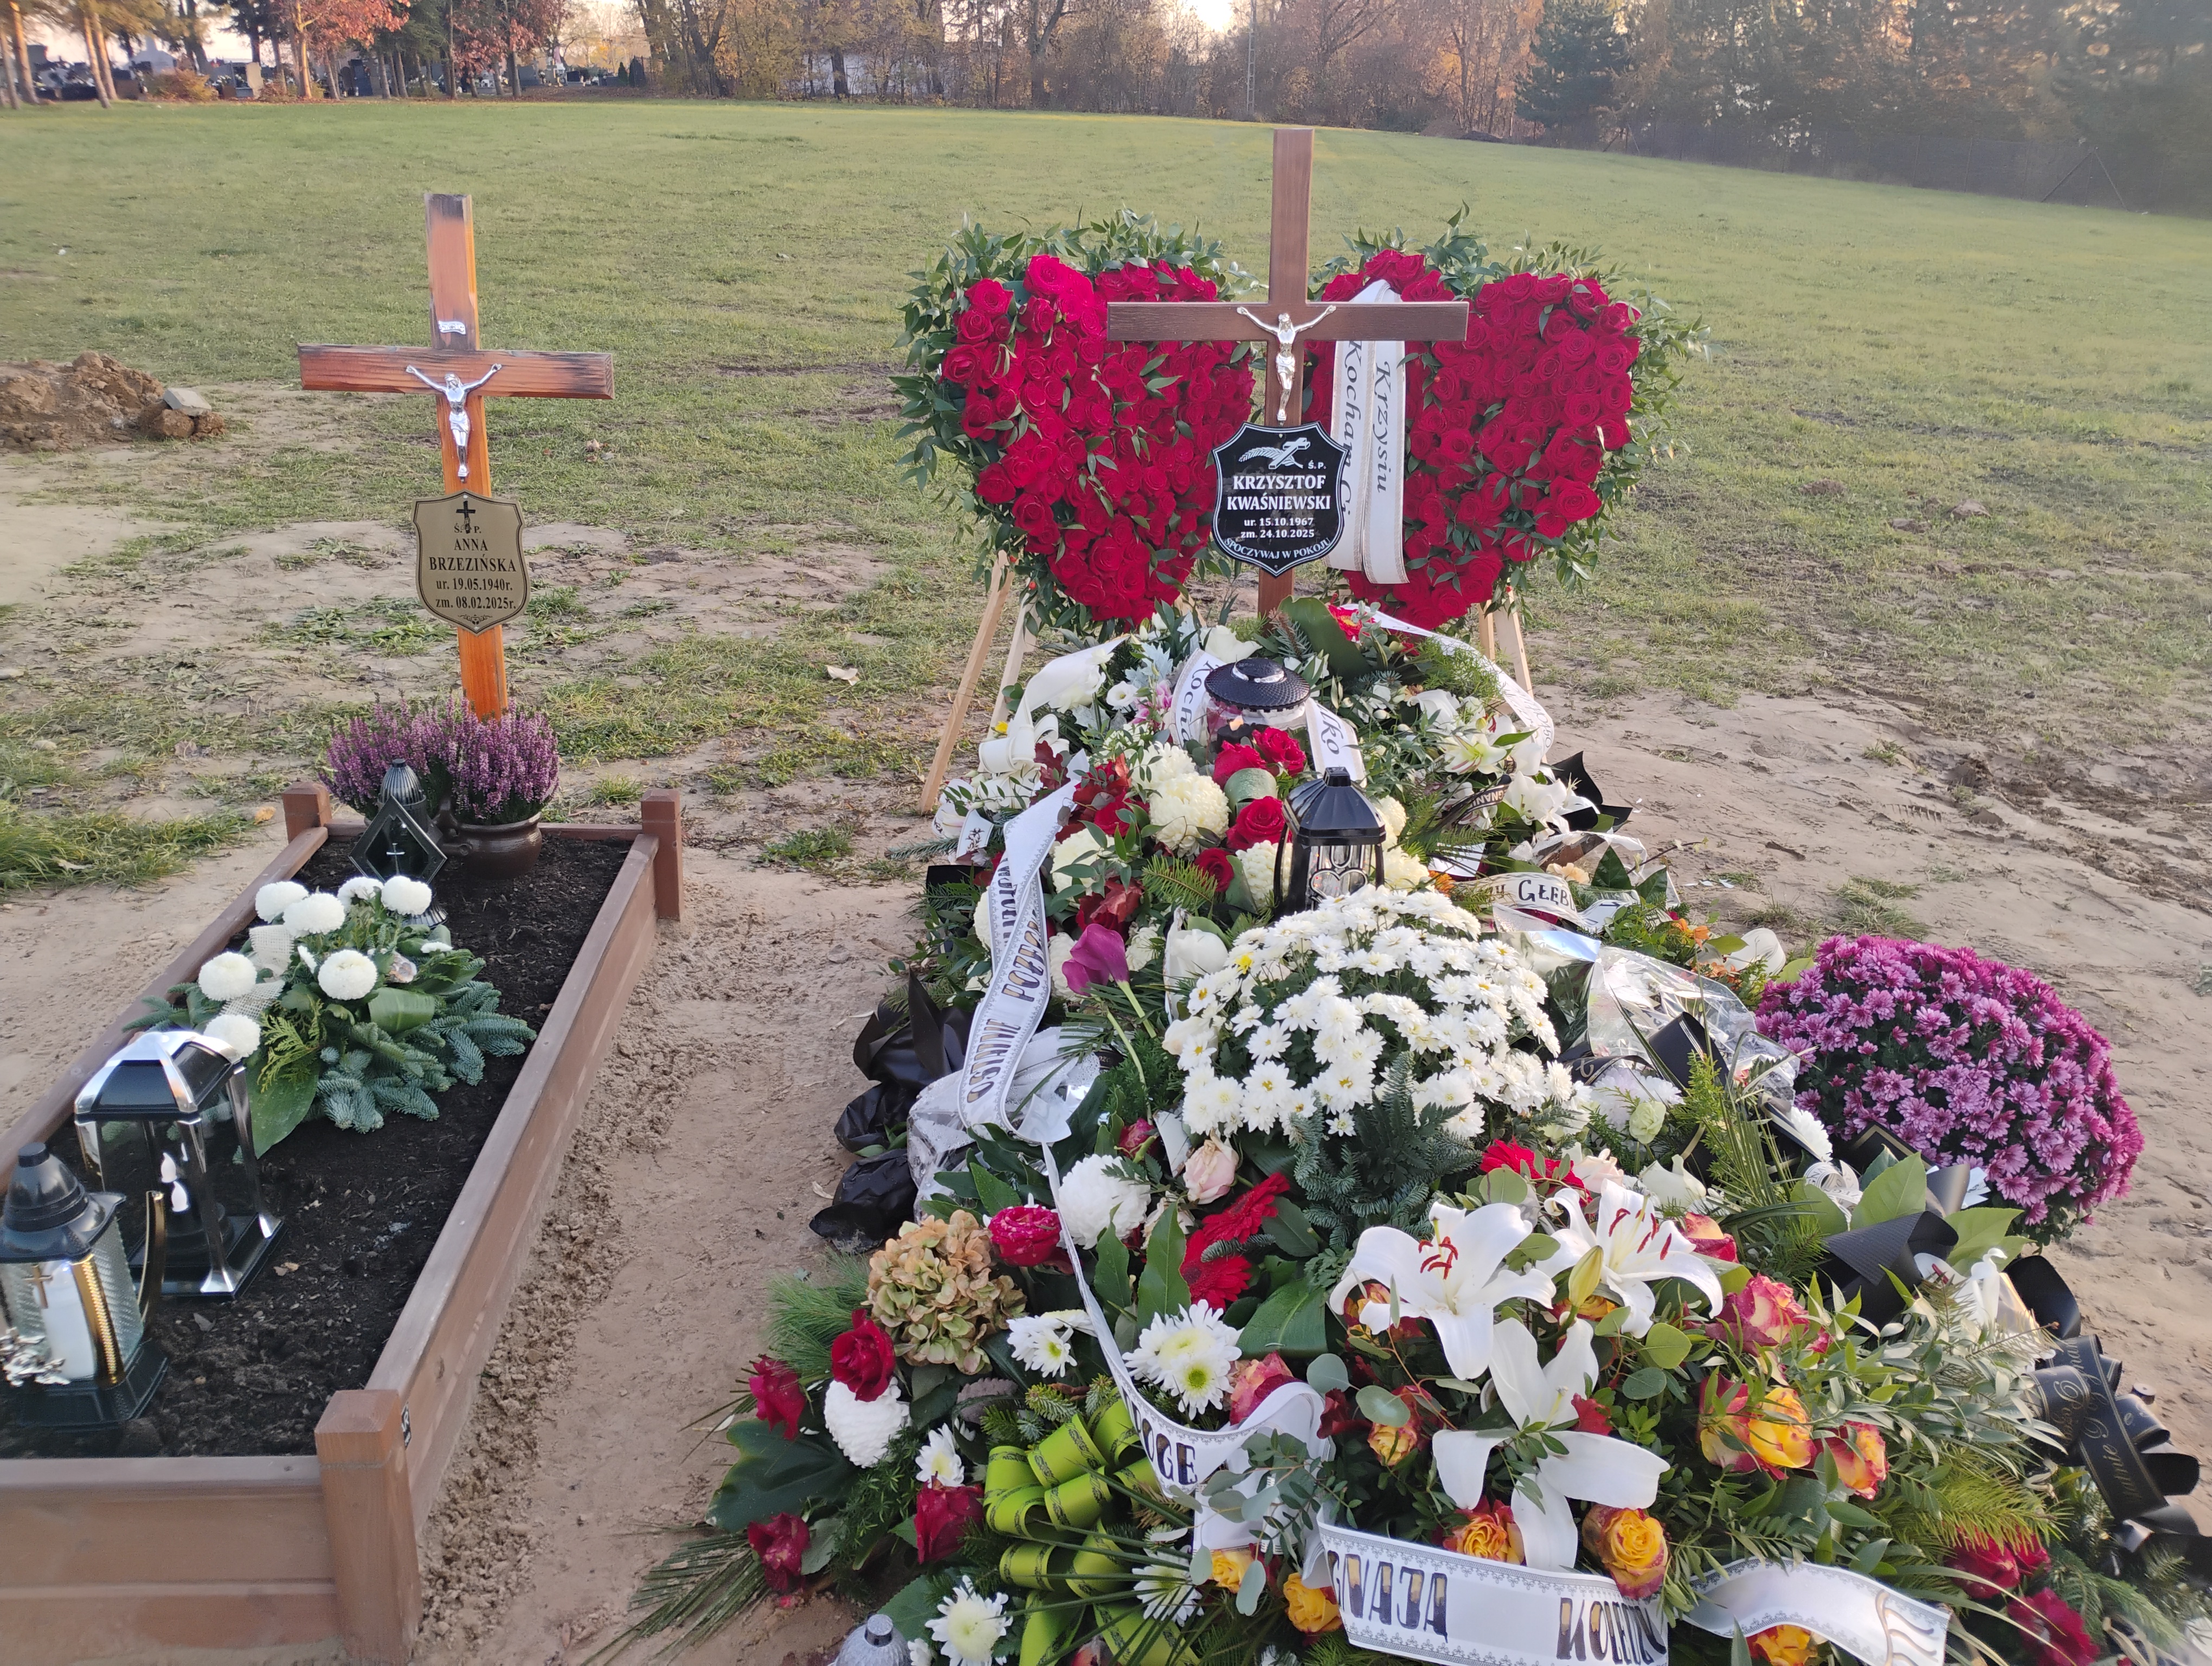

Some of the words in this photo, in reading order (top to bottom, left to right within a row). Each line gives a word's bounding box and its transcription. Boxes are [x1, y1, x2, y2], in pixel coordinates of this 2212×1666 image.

[1342, 341, 1362, 467] Kocham
[1373, 361, 1391, 494] Krzysiu
[1233, 475, 1326, 490] KRZYSZTOF
[1227, 492, 1331, 510] KWAŚNIEWSKI
[1259, 517, 1314, 527] 15.10.1967
[1260, 529, 1315, 538] 24.10.2025
[454, 538, 488, 551] ANNA
[1224, 537, 1280, 559] SPOCZYWAJ
[1282, 550, 1291, 559] W
[1294, 537, 1331, 558] POKOJU
[429, 554, 517, 572] BRZEZIŃSKA
[436, 580, 449, 589] ur.
[452, 578, 513, 591] 19.05.1940r.
[435, 599, 453, 608] zm.
[456, 596, 516, 609] 08.02.2025r.
[967, 1018, 1021, 1103] OSTATNIE
